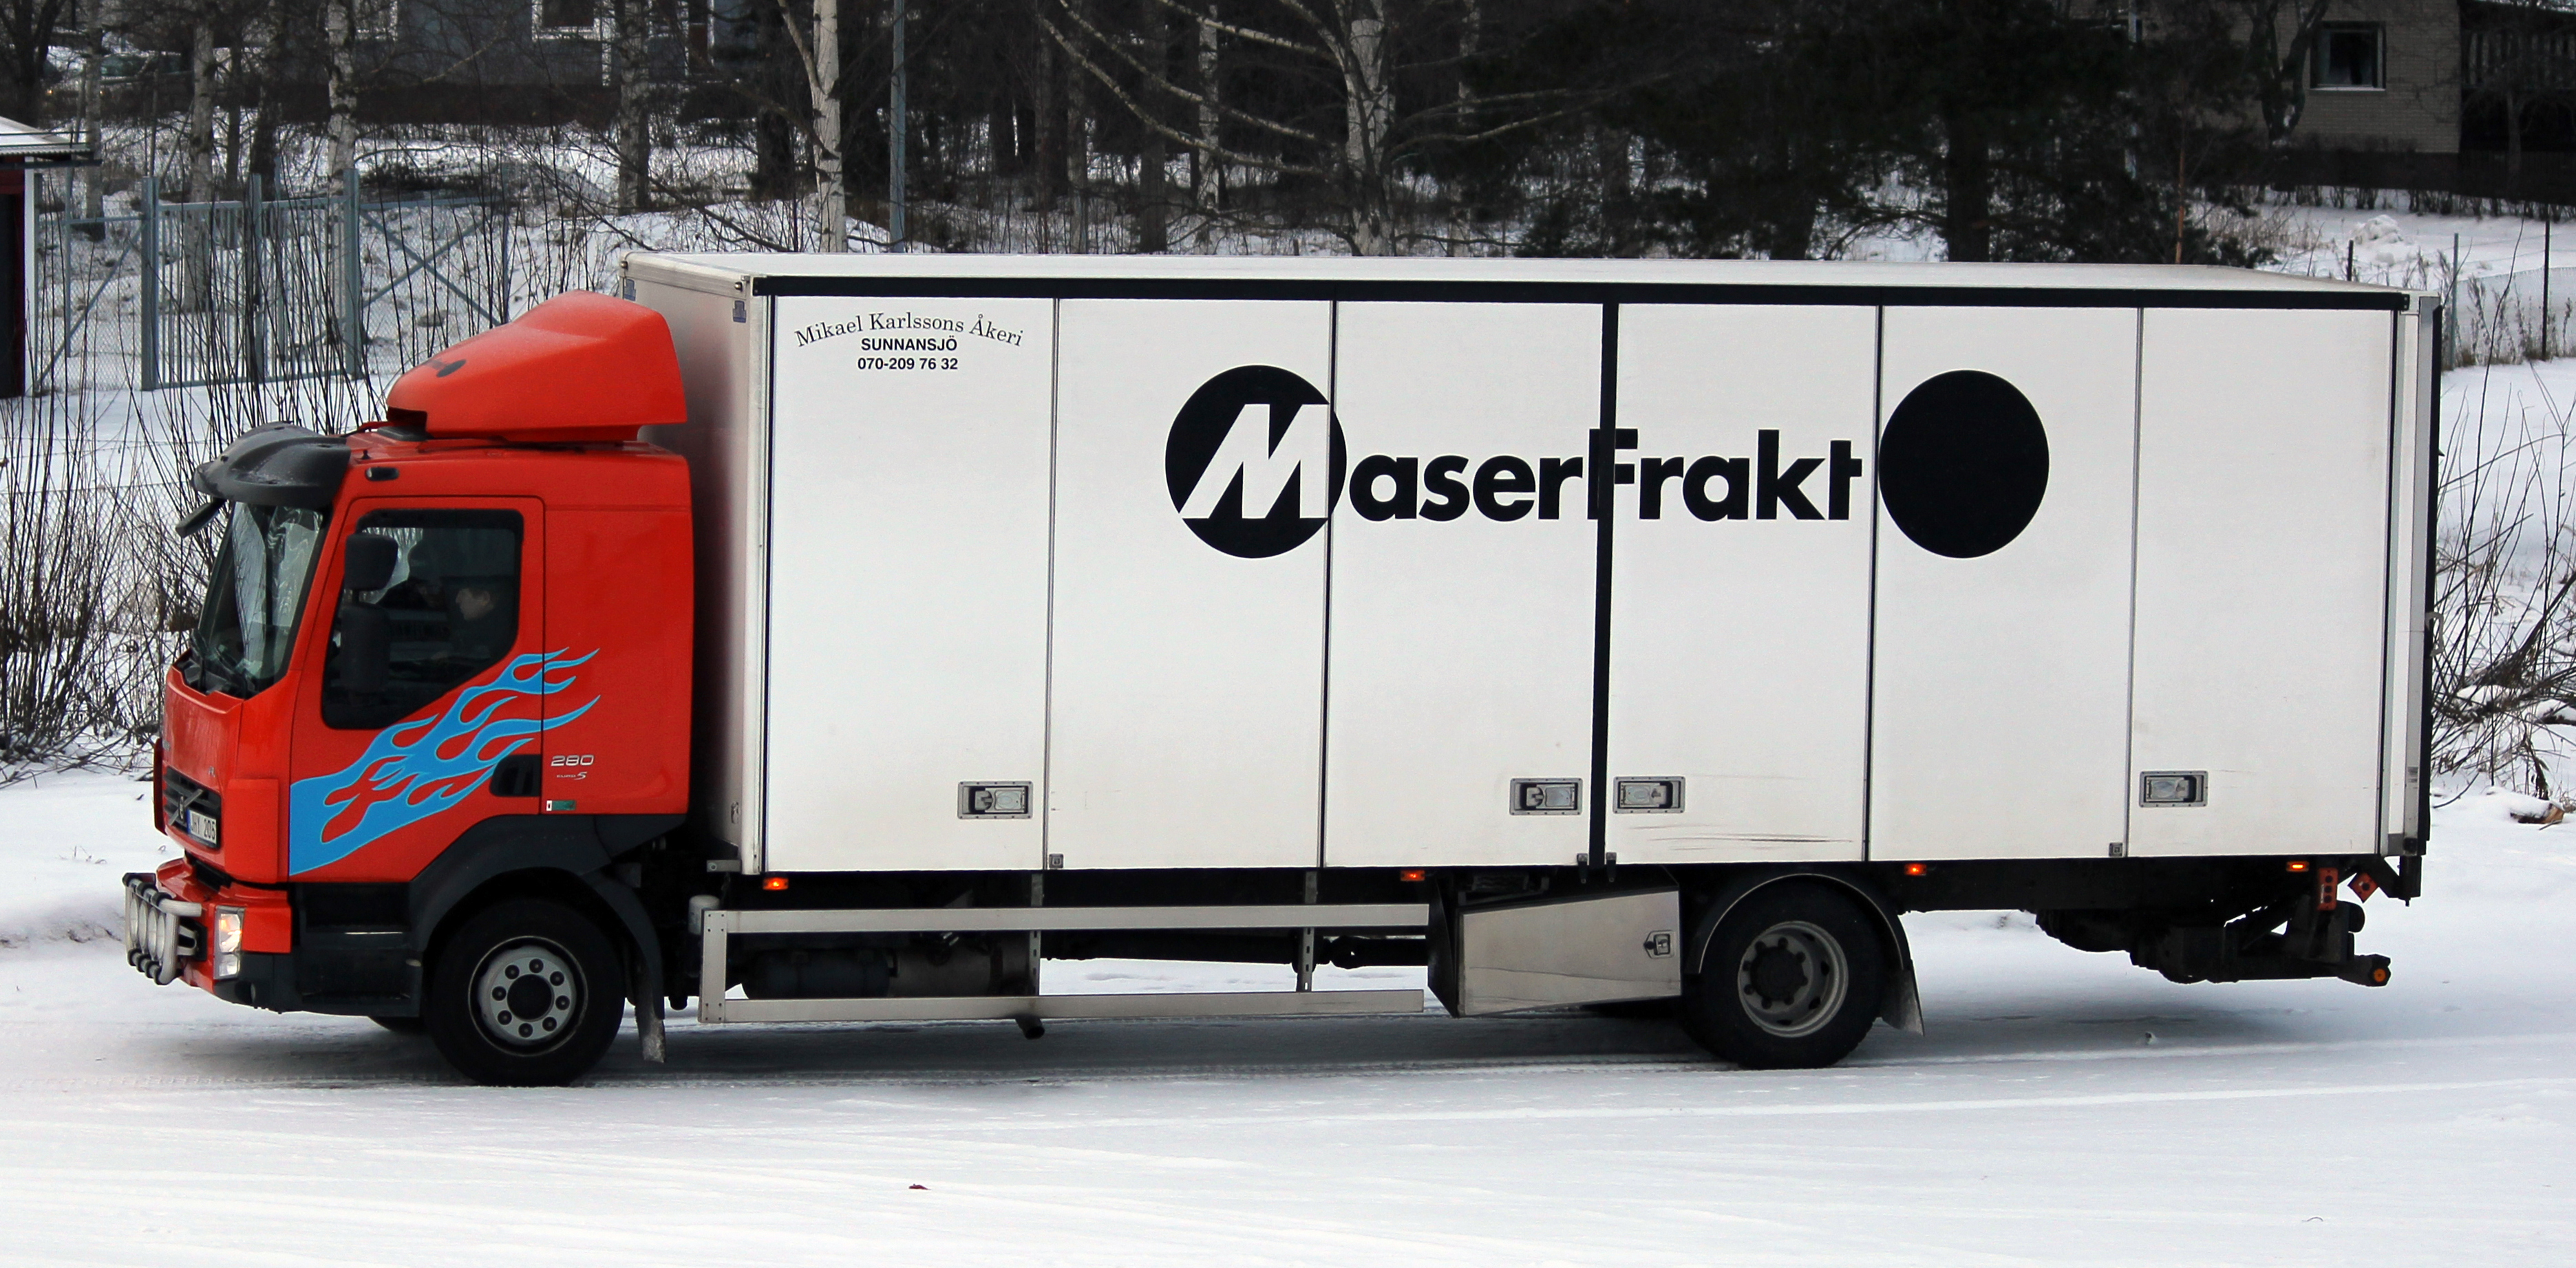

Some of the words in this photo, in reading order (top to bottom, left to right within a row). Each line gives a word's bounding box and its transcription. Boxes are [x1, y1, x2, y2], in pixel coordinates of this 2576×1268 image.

[794, 315, 863, 347] Mikael
[869, 312, 964, 332] Karlssons
[968, 314, 1023, 347] Åkeri
[861, 335, 957, 351] SUNNANSJÖ
[858, 357, 915, 370] 070-209
[919, 357, 937, 370] 76
[941, 357, 958, 370] 32
[1180, 403, 1862, 523] MaserFrakt
[551, 754, 595, 766] 280
[204, 817, 215, 840] 205
